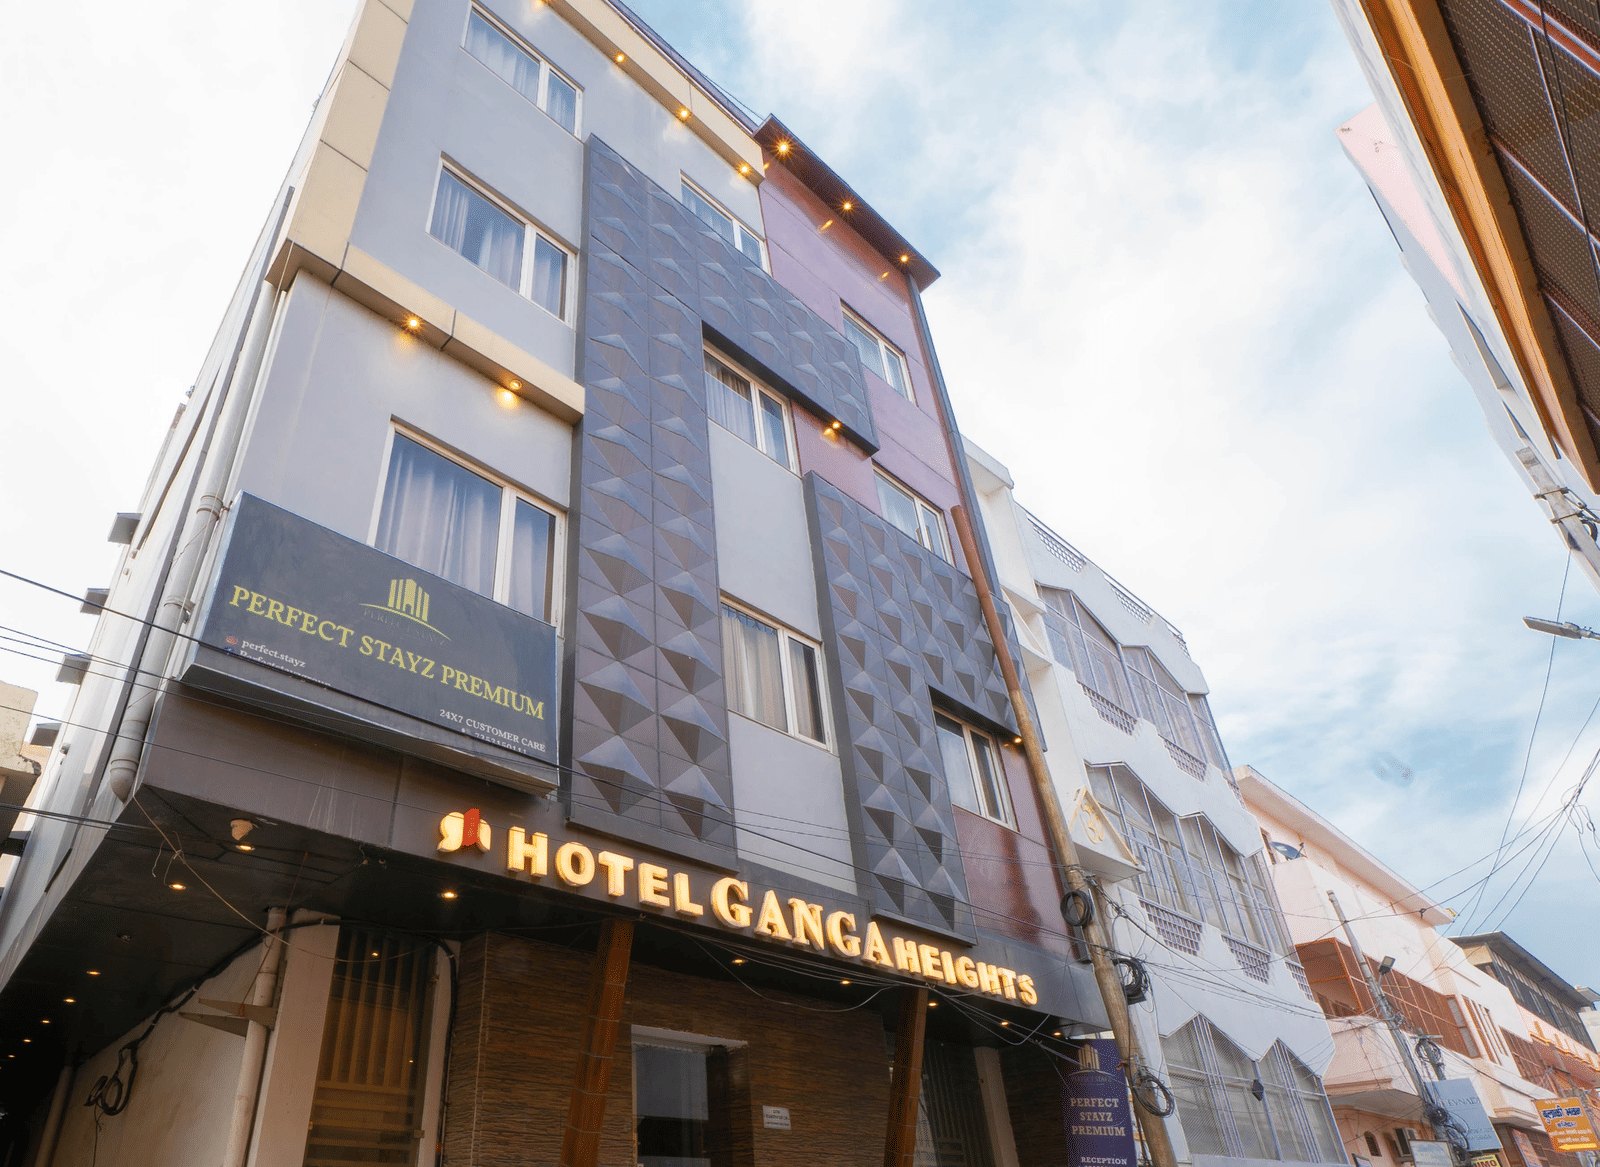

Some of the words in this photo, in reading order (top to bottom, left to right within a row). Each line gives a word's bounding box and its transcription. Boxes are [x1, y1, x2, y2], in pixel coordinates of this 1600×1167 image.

[229, 584, 355, 648] PERFECT
[358, 634, 435, 680] STAYZ
[440, 664, 545, 721] PREMIUM
[241, 639, 306, 668] perfect.stayz
[439, 708, 464, 724] 24X7
[465, 718, 520, 744] CUSTOMER
[521, 737, 546, 753] CARE
[506, 825, 704, 917] HOTEL
[710, 876, 895, 969] GANGA
[892, 936, 1038, 1007] HEIGHTS
[1070, 1097, 1119, 1108] PERFECT
[1079, 1111, 1113, 1122] STAYZ
[1072, 1125, 1126, 1137] PREMIUM
[1081, 1156, 1127, 1165] RECEPTION
